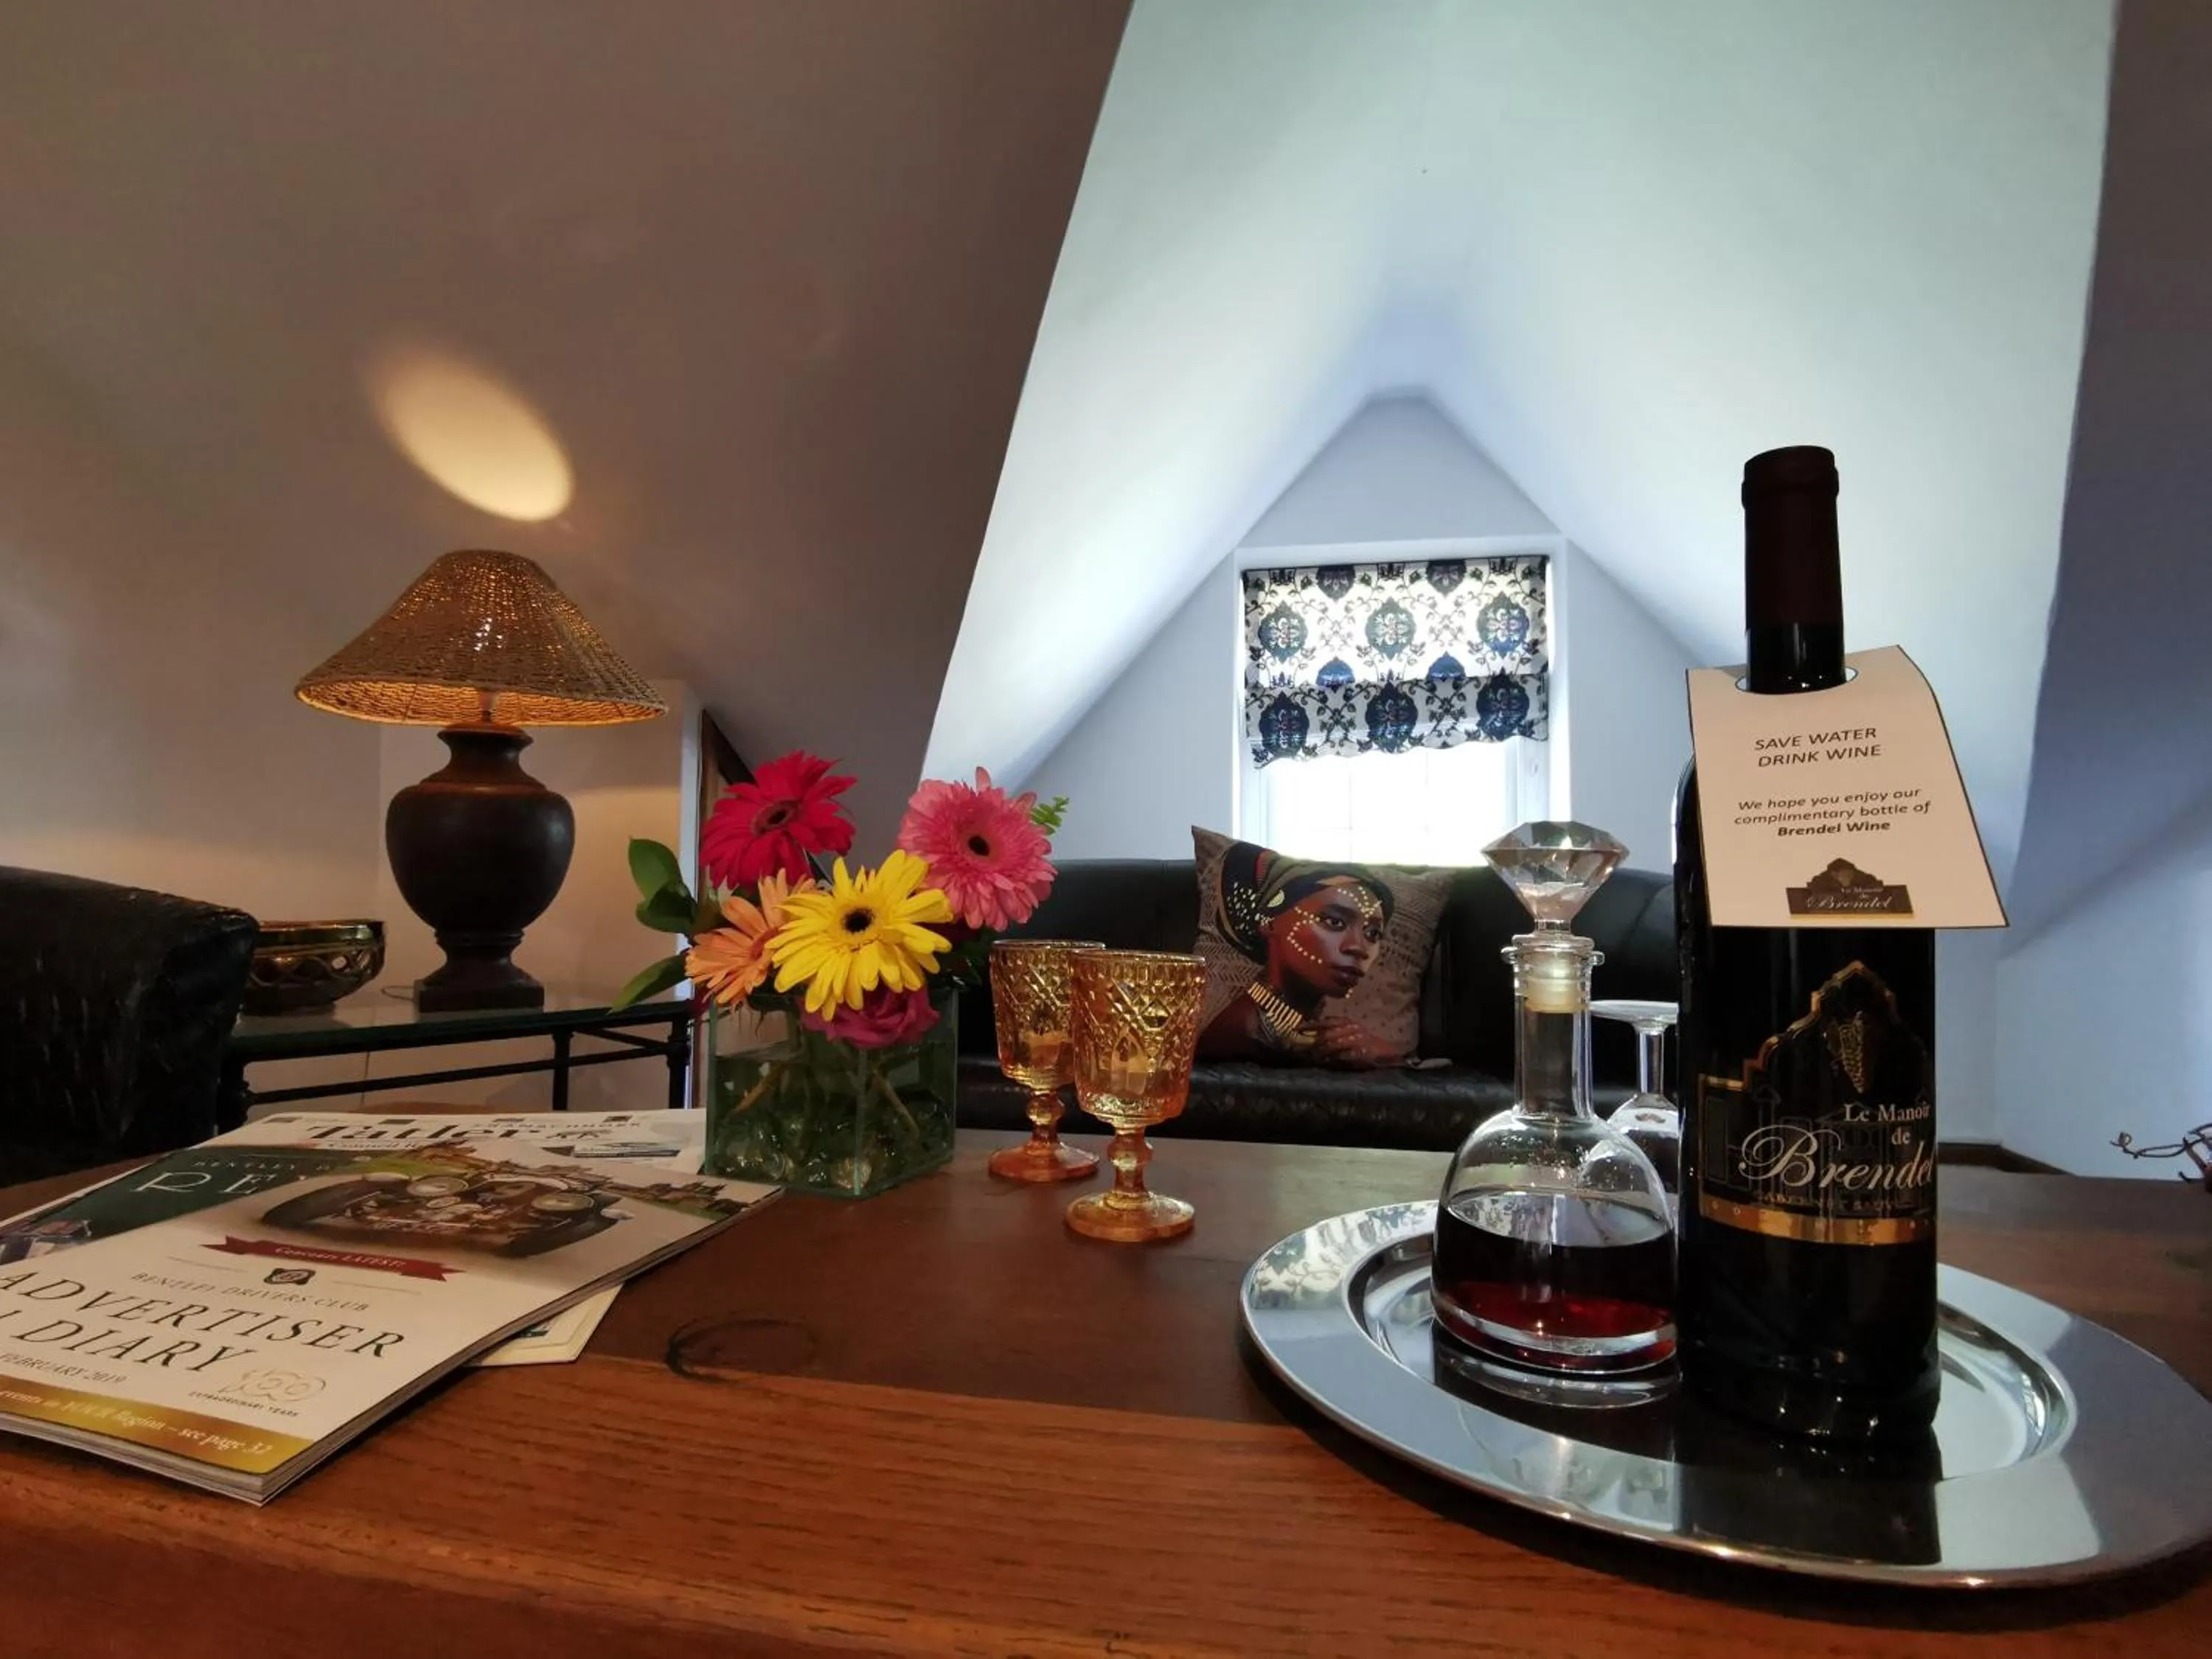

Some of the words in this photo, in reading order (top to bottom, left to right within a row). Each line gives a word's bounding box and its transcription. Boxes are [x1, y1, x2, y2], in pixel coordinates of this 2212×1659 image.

[1753, 734, 1803, 751] SAVE
[1808, 728, 1877, 747] WATER
[1758, 751, 1820, 768] DRINK
[1826, 745, 1882, 761] WINE
[1738, 801, 1763, 810] We
[1767, 797, 1806, 812] hope
[1810, 795, 1840, 807] you
[1843, 790, 1889, 804] enjoy
[1893, 788, 1921, 799] our
[1734, 810, 1856, 825] complimentary
[1860, 803, 1908, 816] bottle
[1913, 800, 1932, 815] of
[1777, 822, 1842, 837] Brendel
[1846, 820, 1891, 832] Wine
[1844, 1103, 1870, 1122] Le
[1891, 1127, 1911, 1146] de
[221, 1287, 313, 1304] DRIVERS
[314, 1297, 369, 1311] CLUB
[0, 1271, 404, 1358] ADVERTISER
[11, 1319, 257, 1372] DIARY
